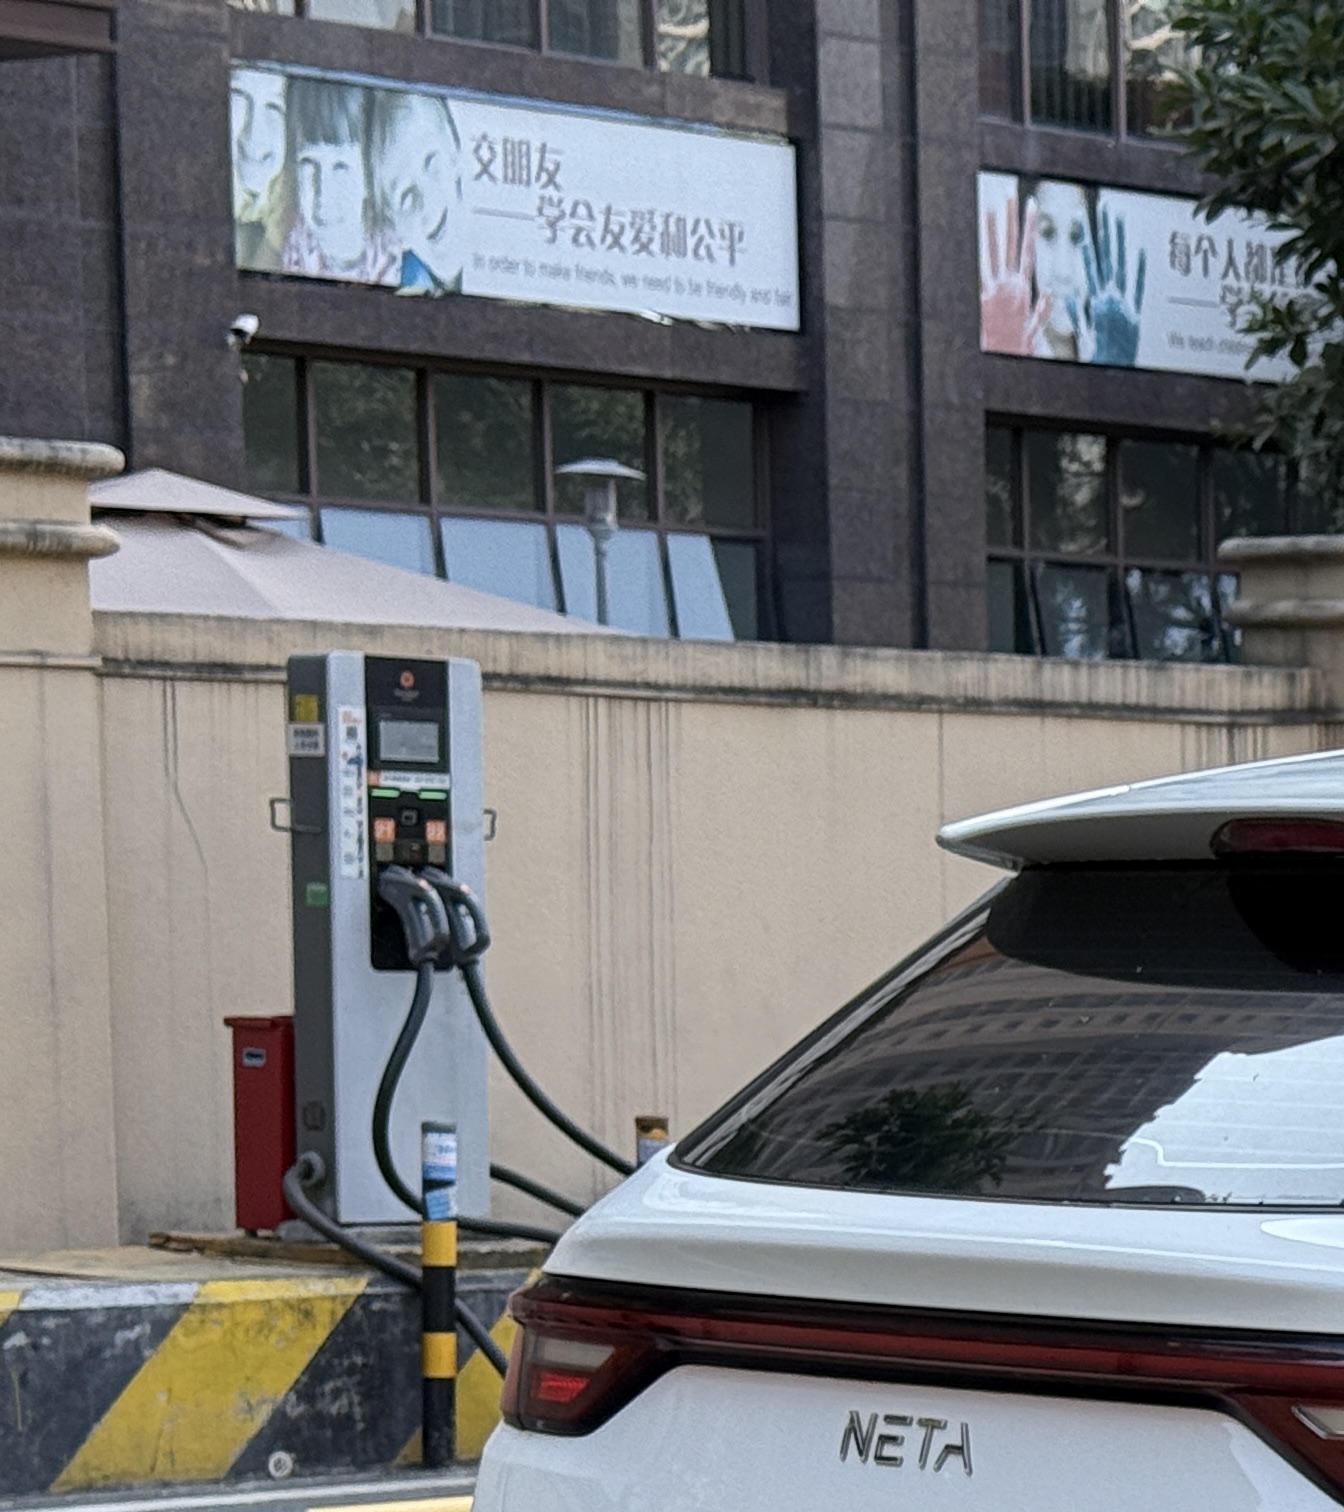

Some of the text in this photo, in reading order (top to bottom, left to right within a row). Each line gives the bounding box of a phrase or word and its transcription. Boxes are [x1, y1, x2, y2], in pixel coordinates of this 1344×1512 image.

[471, 131, 563, 192] 交朋友
[839, 1410, 973, 1478] NETA
